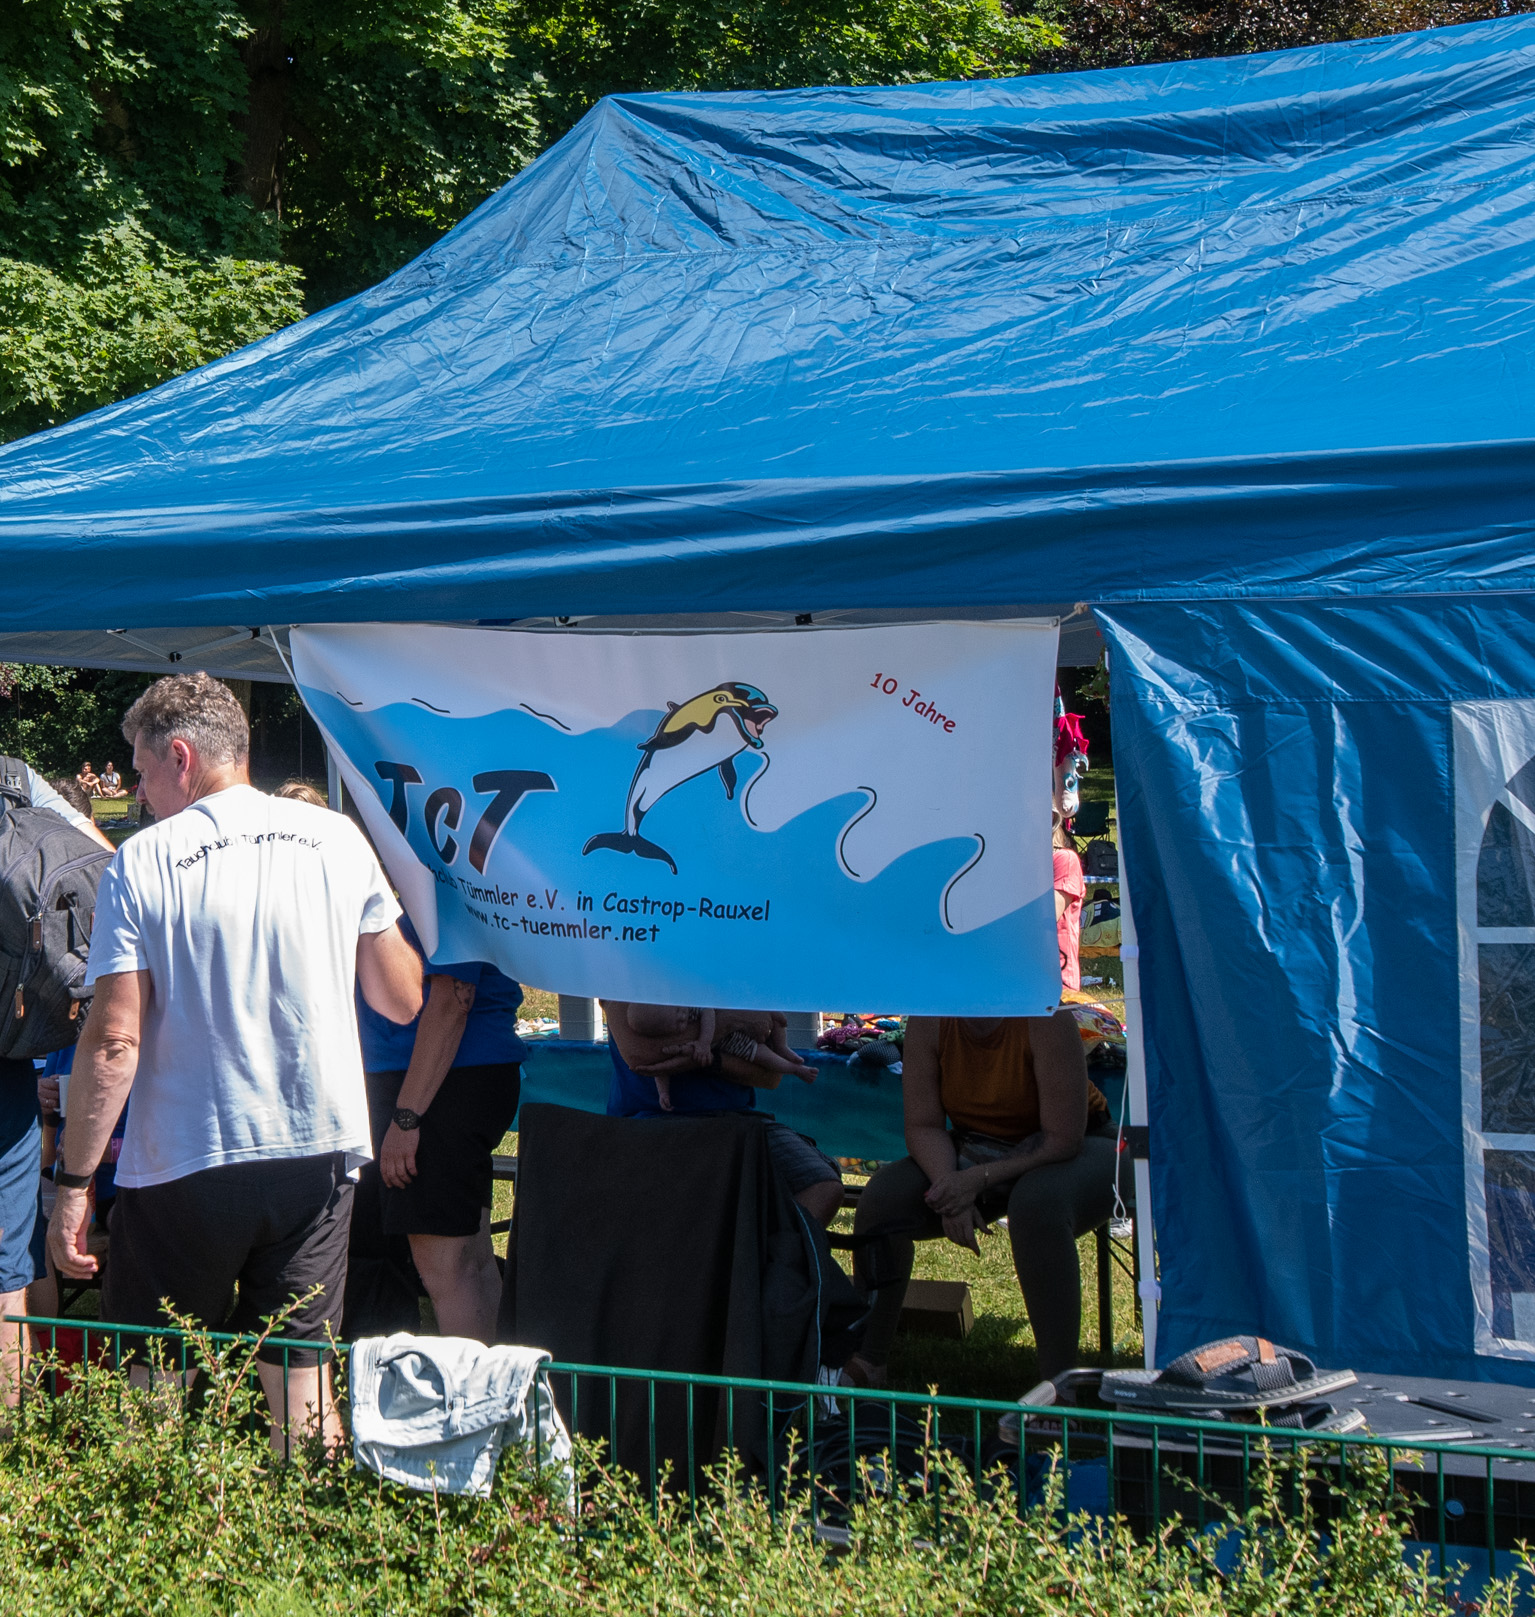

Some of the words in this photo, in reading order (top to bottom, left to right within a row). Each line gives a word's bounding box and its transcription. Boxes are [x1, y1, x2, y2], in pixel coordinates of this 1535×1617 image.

[869, 672, 898, 695] 10
[901, 688, 956, 734] Jahre
[456, 876, 519, 907] Tümmler
[526, 888, 565, 911] e.V.
[576, 890, 593, 912] in
[602, 891, 771, 923] Castrop-Rauxel
[464, 902, 661, 943] www.tc-tuemmler.net
